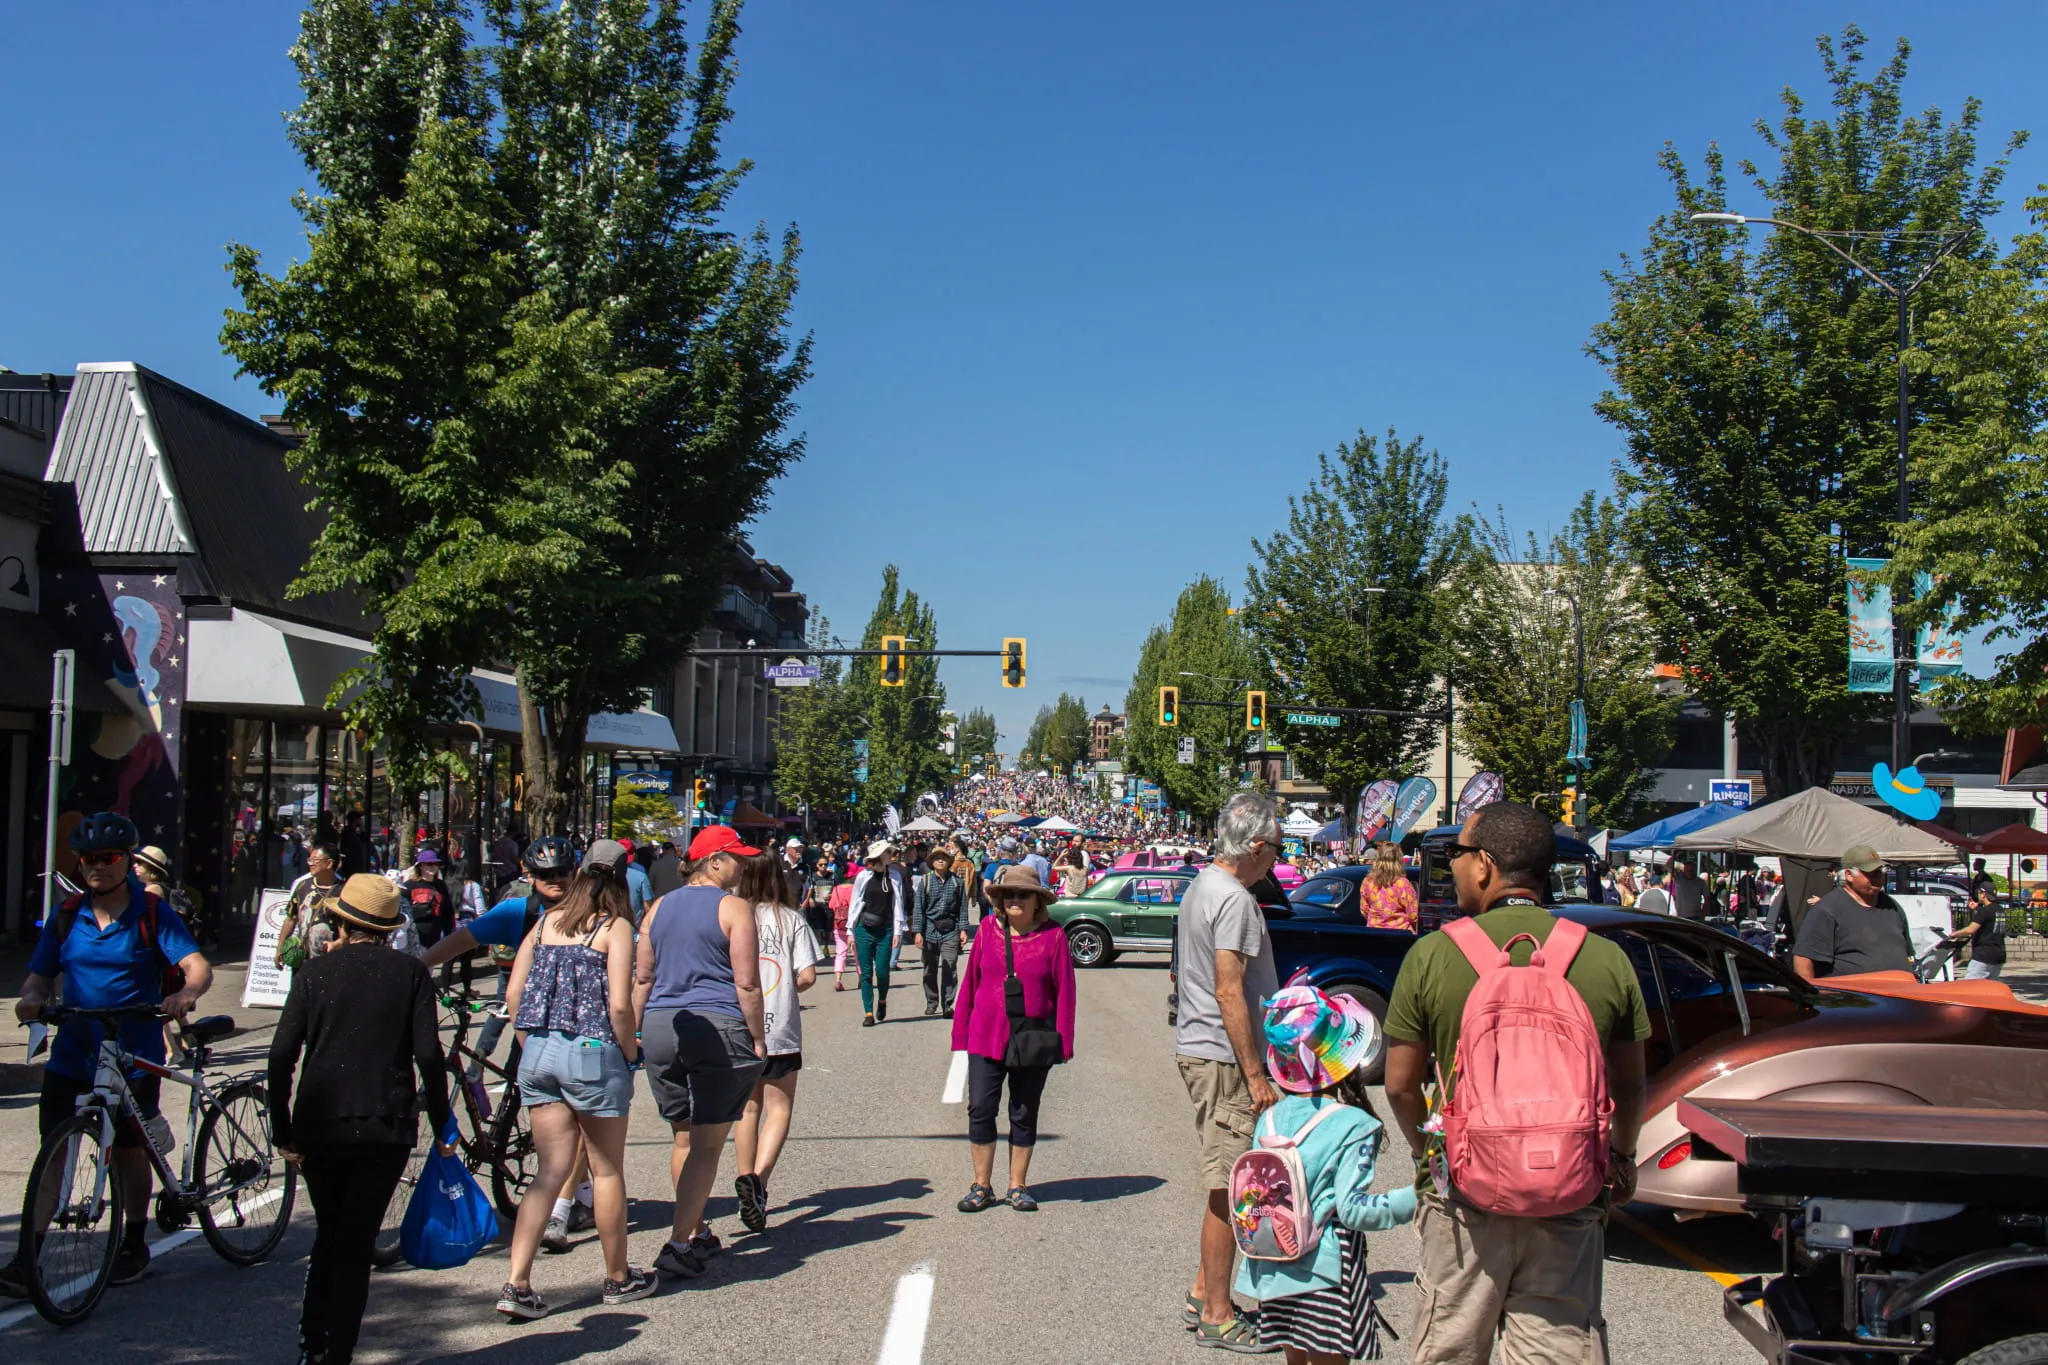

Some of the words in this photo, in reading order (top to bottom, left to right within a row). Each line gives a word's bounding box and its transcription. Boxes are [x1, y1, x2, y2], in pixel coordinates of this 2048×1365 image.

[768, 667, 803, 677] ALPHA
[1290, 715, 1330, 725] ALPHA
[1713, 791, 1749, 801] RINGER
[1396, 789, 1428, 827] Aquatics
[253, 970, 280, 979] Pastries
